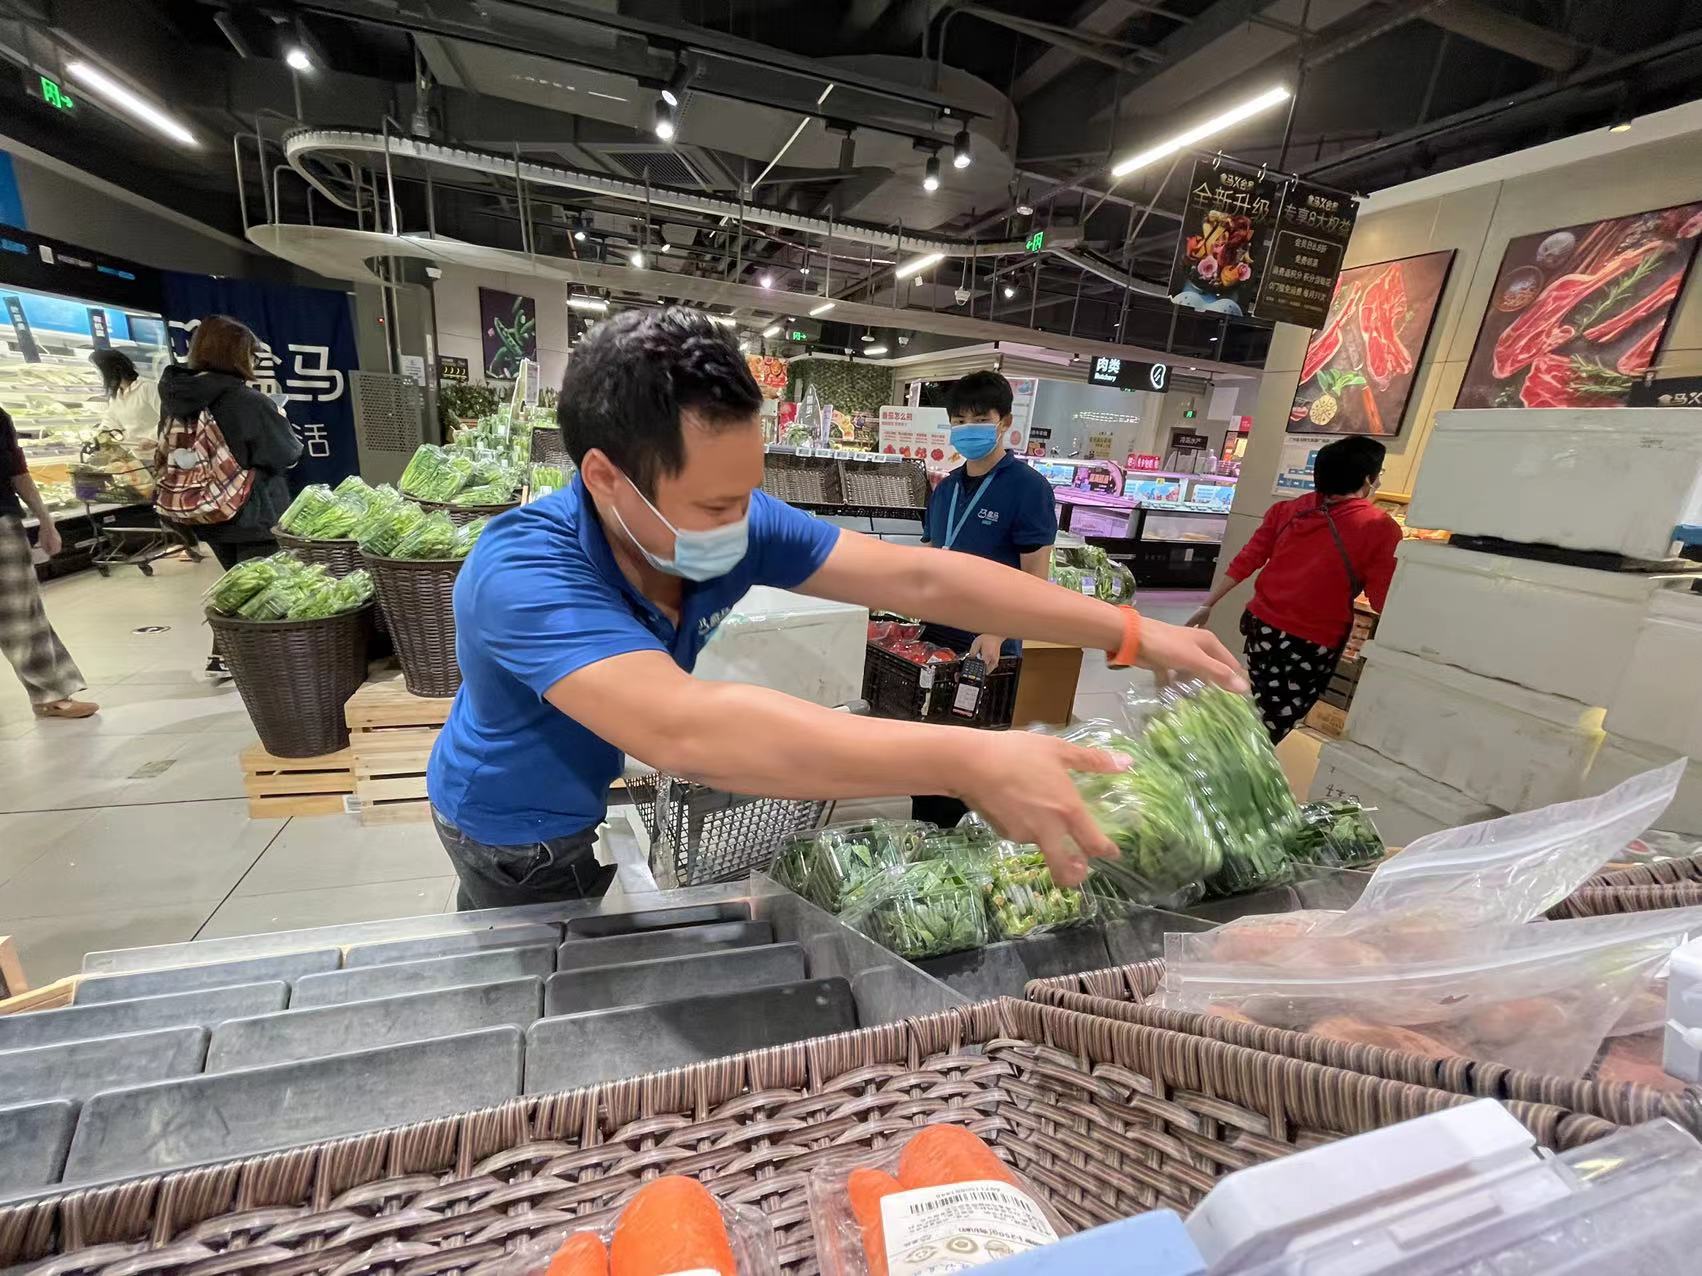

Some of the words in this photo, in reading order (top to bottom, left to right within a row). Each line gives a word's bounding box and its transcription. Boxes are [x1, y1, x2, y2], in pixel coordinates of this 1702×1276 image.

[1192, 182, 1270, 222] 全新升级
[1096, 357, 1121, 374] 肉类
